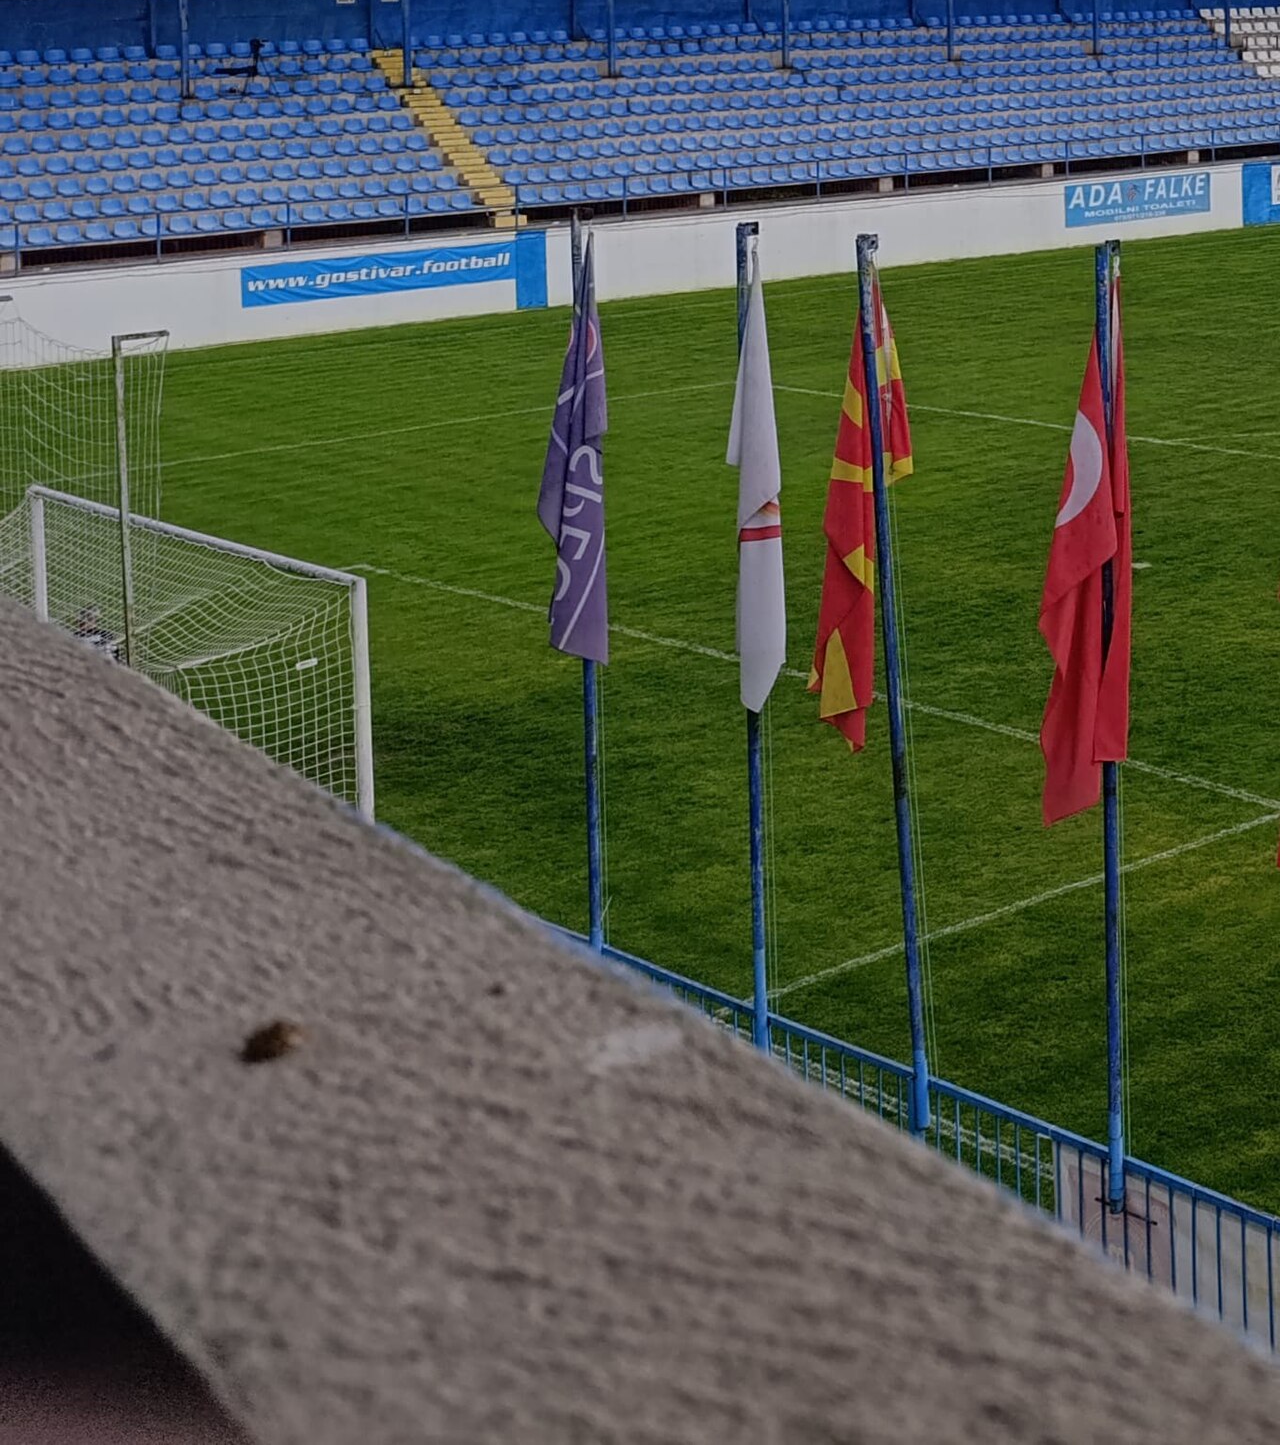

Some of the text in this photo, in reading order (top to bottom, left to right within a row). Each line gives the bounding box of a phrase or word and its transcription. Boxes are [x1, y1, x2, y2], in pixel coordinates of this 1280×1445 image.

[1068, 174, 1206, 209] ADA FALKE
[1084, 205, 1140, 218] MOBILNI
[1144, 199, 1196, 211] TOALETI
[247, 253, 511, 292] www.gostivar.football
